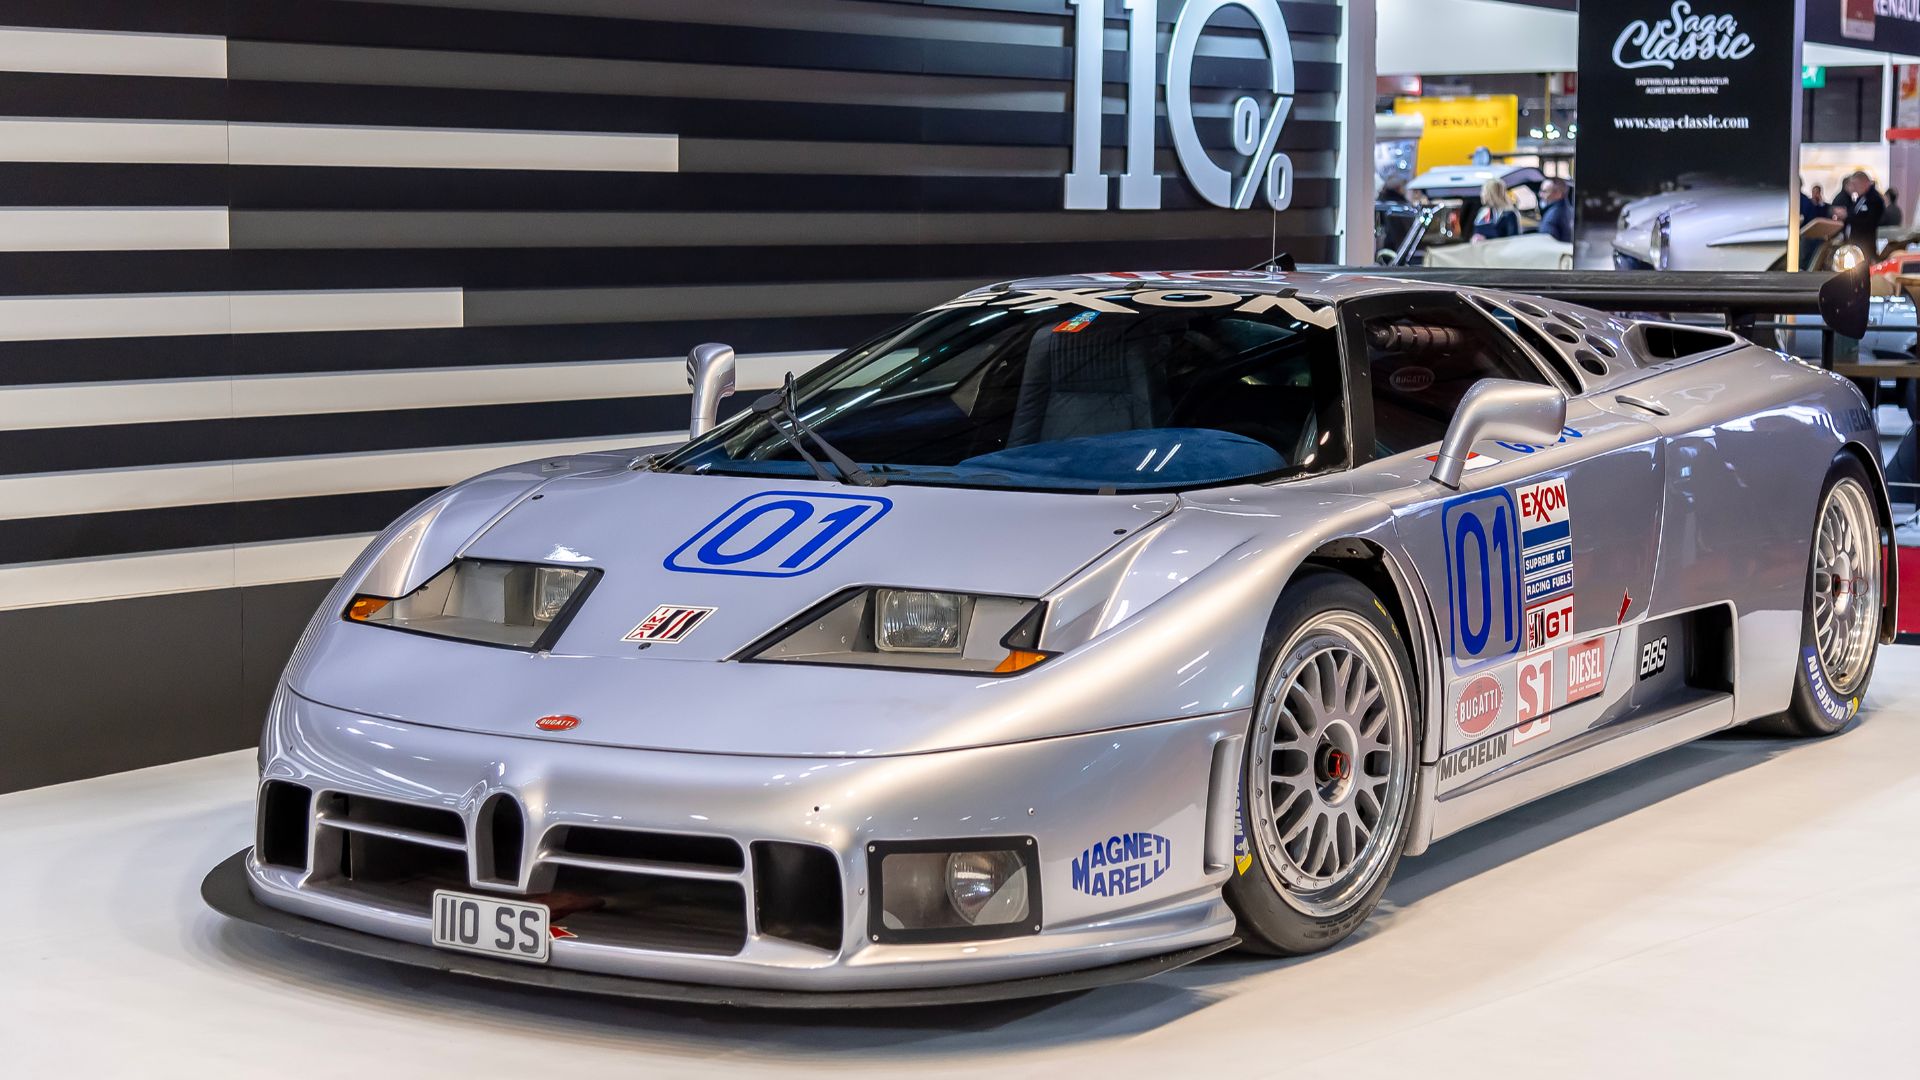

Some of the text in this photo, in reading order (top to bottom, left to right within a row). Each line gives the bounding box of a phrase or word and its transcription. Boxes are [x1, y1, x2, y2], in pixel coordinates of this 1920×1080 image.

[1660, 0, 1738, 41] Saga
[1612, 20, 1755, 70] Classic
[1431, 115, 1499, 128] RENAULT
[1614, 114, 1749, 132] www.saga-classic.com
[1521, 485, 1566, 522] EXXON
[697, 500, 872, 568] 01
[1456, 505, 1513, 655] 01
[1525, 549, 1566, 570] SUPREME GT
[1526, 573, 1571, 596] RACING FUELS
[1546, 606, 1573, 638] GT
[1570, 648, 1602, 687] DIESEL
[1640, 635, 1668, 677] BBS
[1460, 688, 1498, 723] BUGATTI
[1518, 660, 1552, 733] S1
[1808, 656, 1846, 720] MICHELIN
[540, 719, 576, 727] BUGATTI
[1441, 734, 1508, 781] MICHELIN
[1072, 833, 1170, 876] MAGNETI
[1072, 855, 1170, 897] MARELLI
[440, 897, 540, 954] 110 SS
